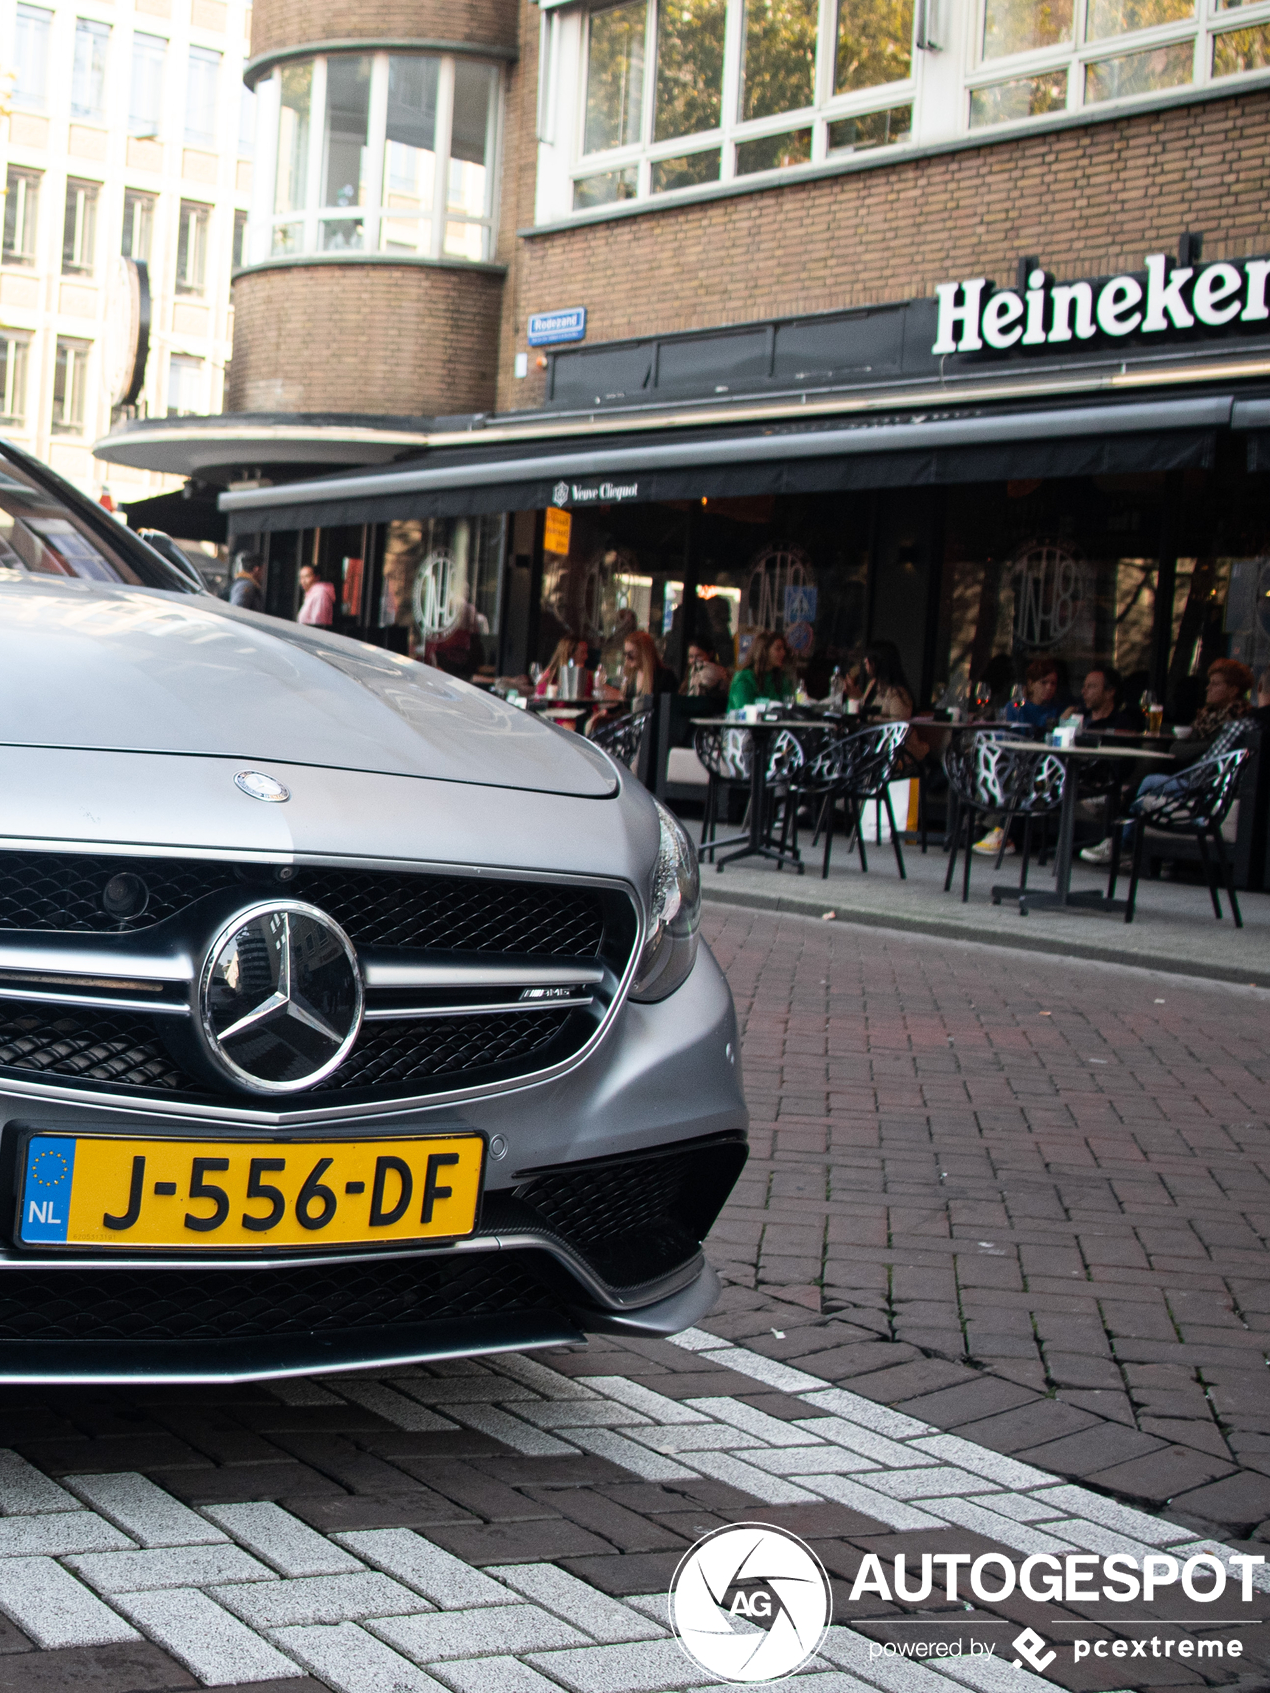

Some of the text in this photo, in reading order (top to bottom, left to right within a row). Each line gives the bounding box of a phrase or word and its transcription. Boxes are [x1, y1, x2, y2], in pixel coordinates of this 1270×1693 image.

[572, 482, 638, 501] Veuve Clicquot
[102, 1152, 459, 1232] J-556-DF
[28, 1200, 61, 1224] NL
